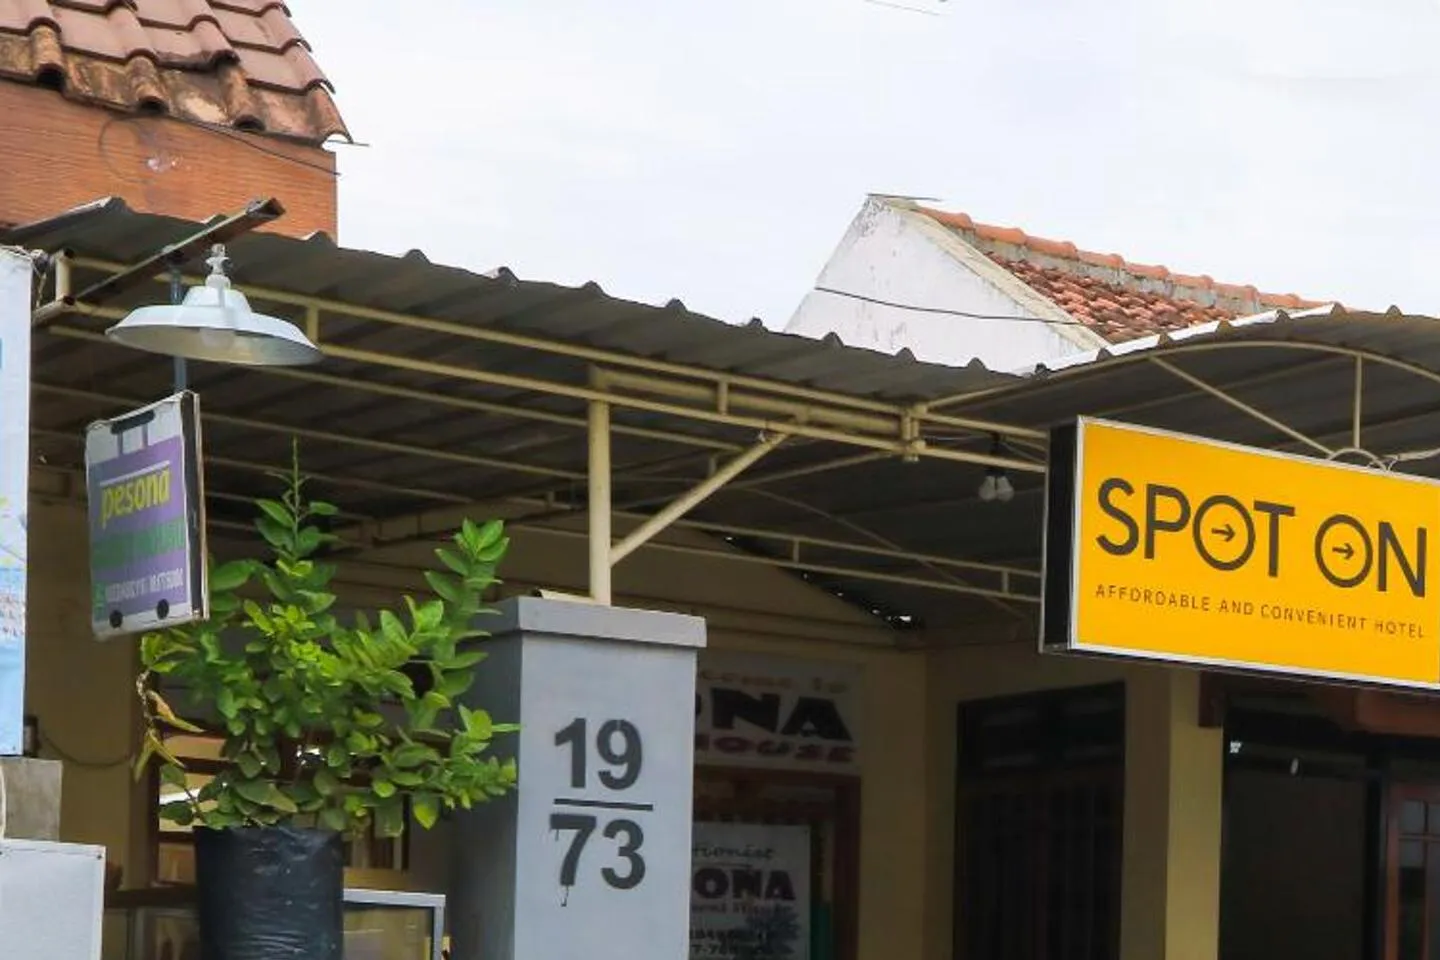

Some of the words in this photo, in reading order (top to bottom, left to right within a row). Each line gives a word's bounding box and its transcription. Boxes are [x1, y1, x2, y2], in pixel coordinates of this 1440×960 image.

[100, 466, 171, 530] pesona
[1095, 476, 1296, 578] SPOT
[1314, 513, 1428, 599] ON
[1095, 584, 1211, 612] AFFORDABLE
[1219, 599, 1255, 617] AND
[1260, 604, 1368, 631] CONVENIENT
[1374, 622, 1426, 640] HOTEL
[697, 685, 854, 743] NA
[553, 717, 643, 791] 19
[549, 812, 646, 890] 73
